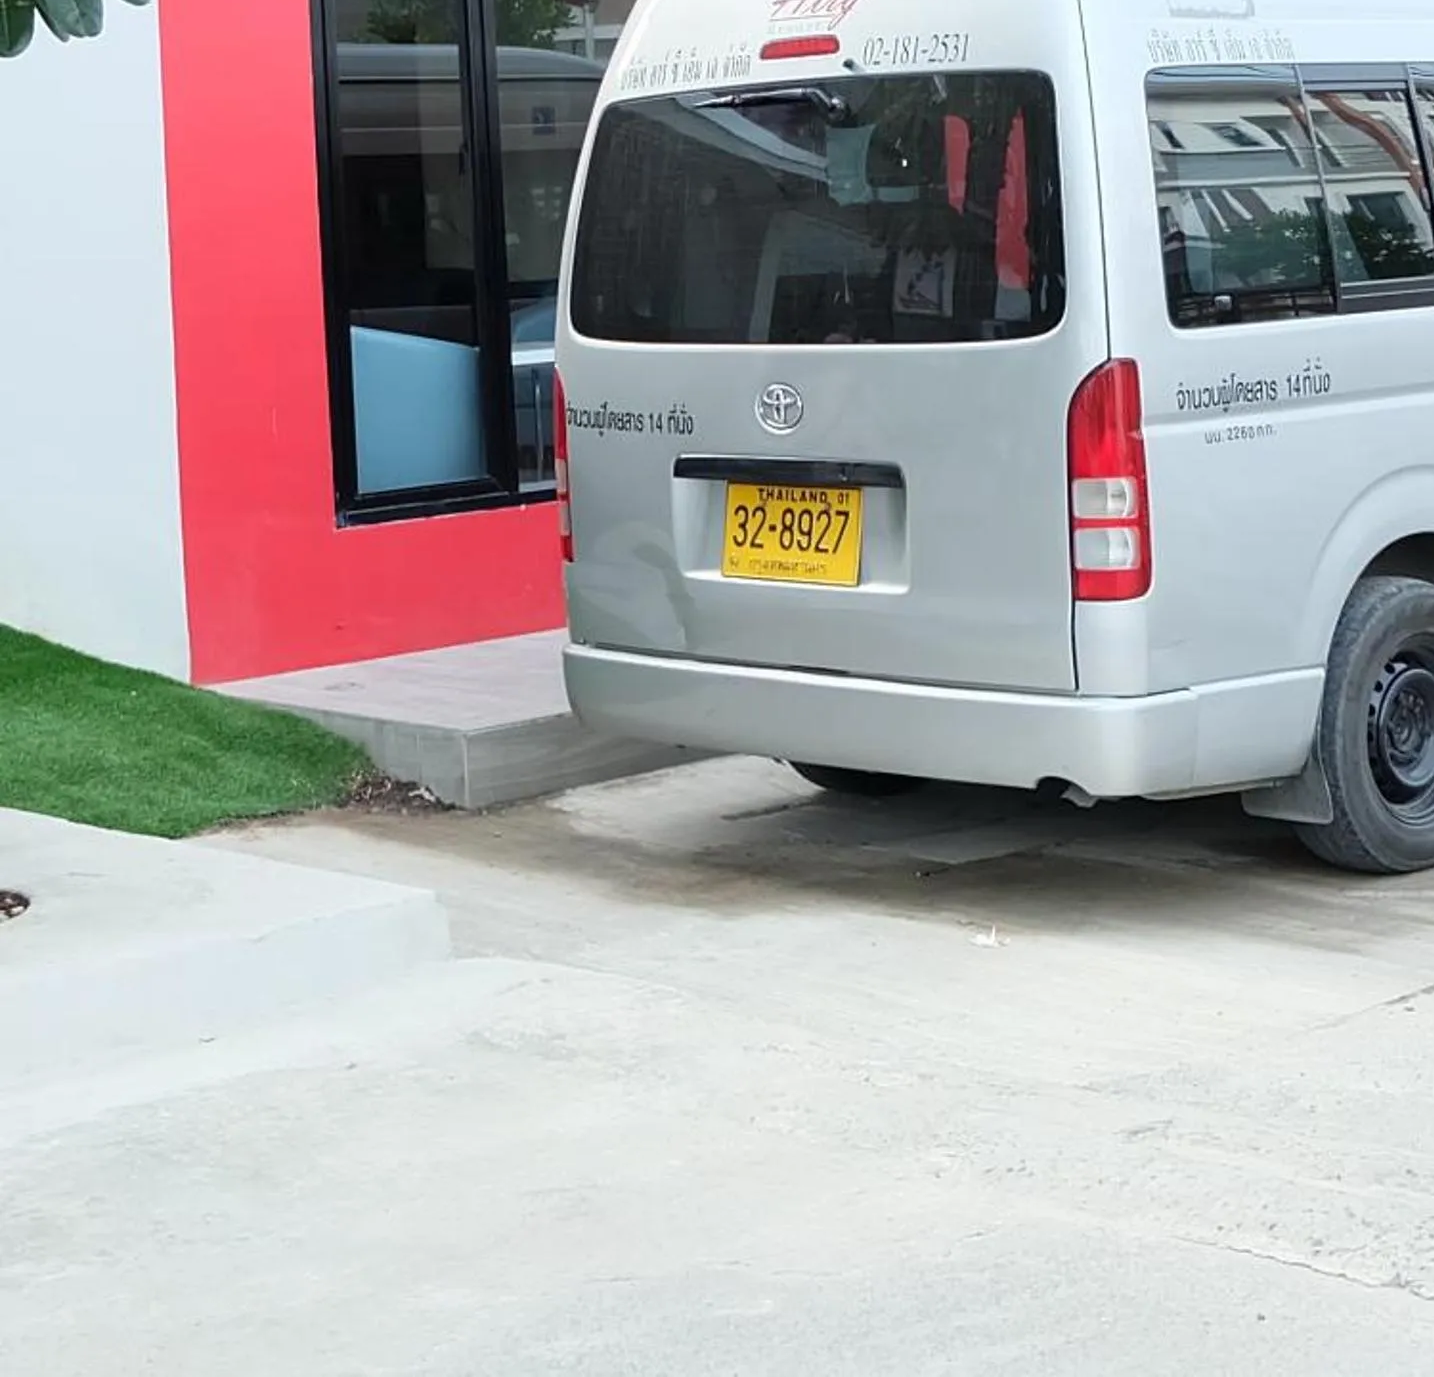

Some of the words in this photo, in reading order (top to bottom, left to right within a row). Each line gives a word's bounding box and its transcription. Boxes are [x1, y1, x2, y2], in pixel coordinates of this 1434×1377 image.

[862, 34, 970, 65] 02-181-2531
[1176, 372, 1278, 413] จำนวนผู้โดยสาร
[1286, 374, 1301, 397] 14
[648, 412, 663, 434] 14
[667, 402, 694, 436] ที่นั่ง
[757, 487, 828, 504] THAILAND
[731, 504, 851, 554] 32-8927
